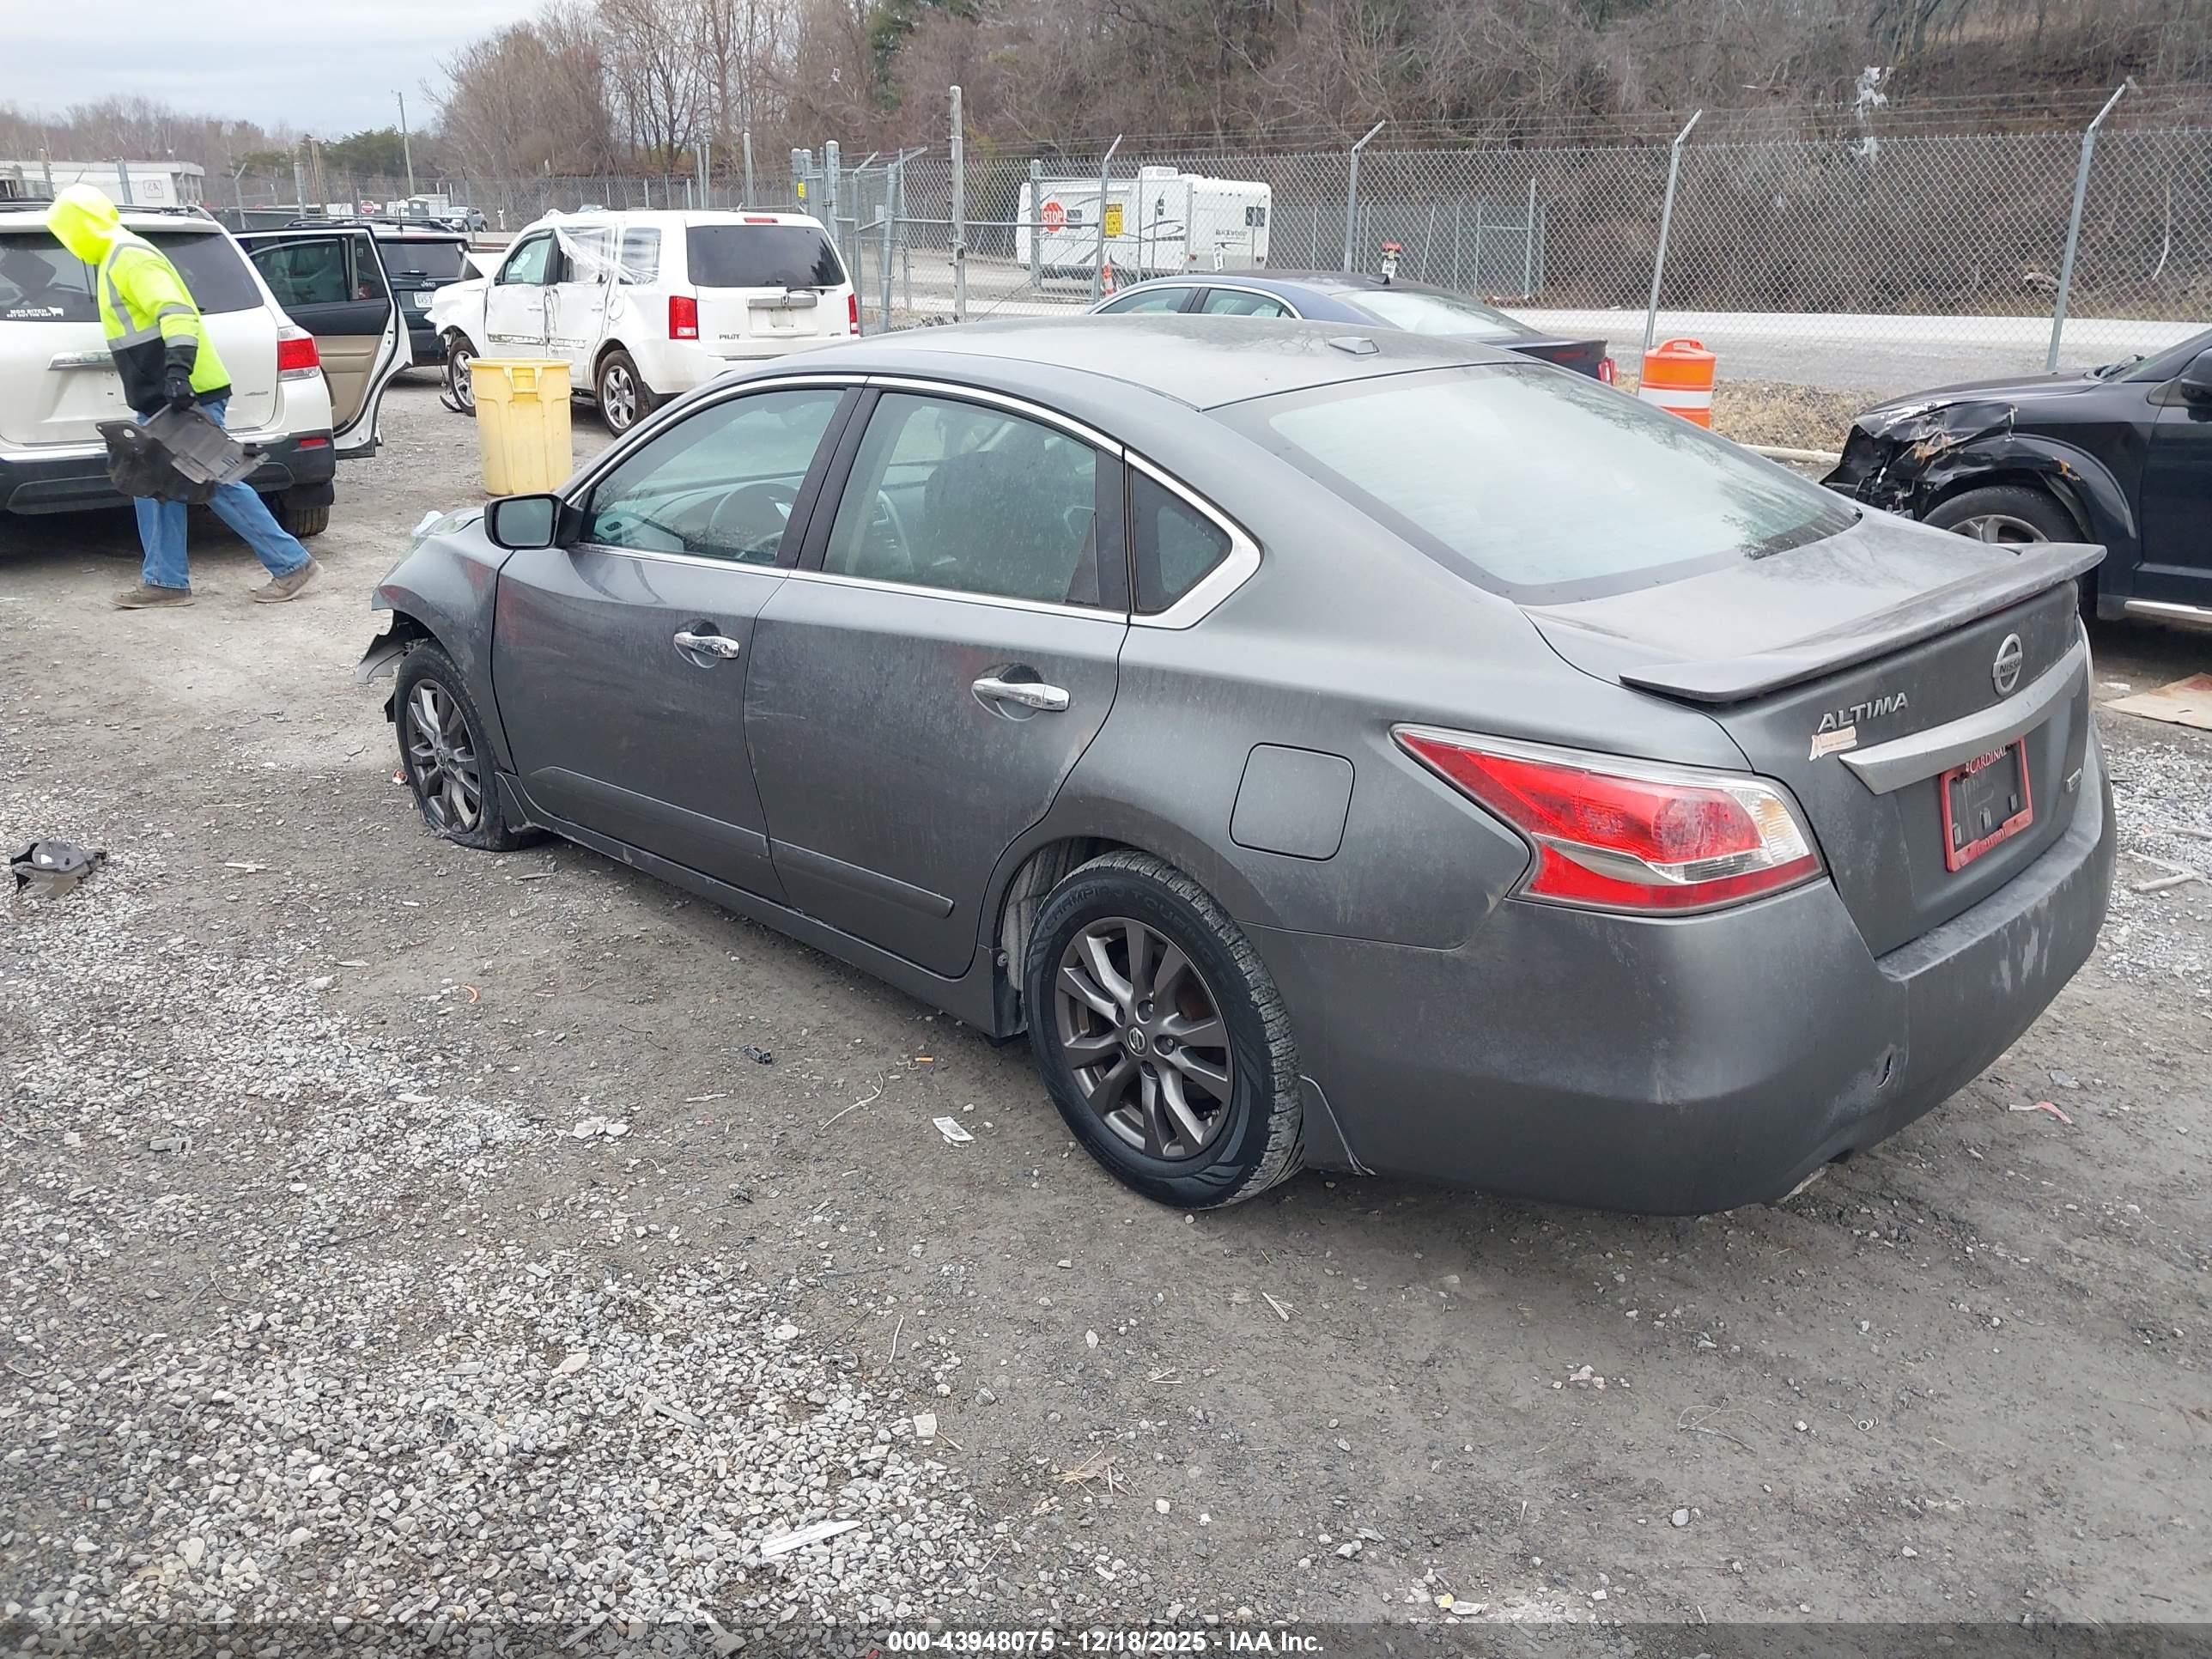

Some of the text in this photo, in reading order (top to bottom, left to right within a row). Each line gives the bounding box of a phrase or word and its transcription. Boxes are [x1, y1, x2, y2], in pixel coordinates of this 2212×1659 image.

[1043, 210, 1063, 223] STOP
[1999, 658, 2020, 674] NISS
[1818, 692, 1909, 733] ALTIMA
[1970, 745, 2007, 774] CARDINAL
